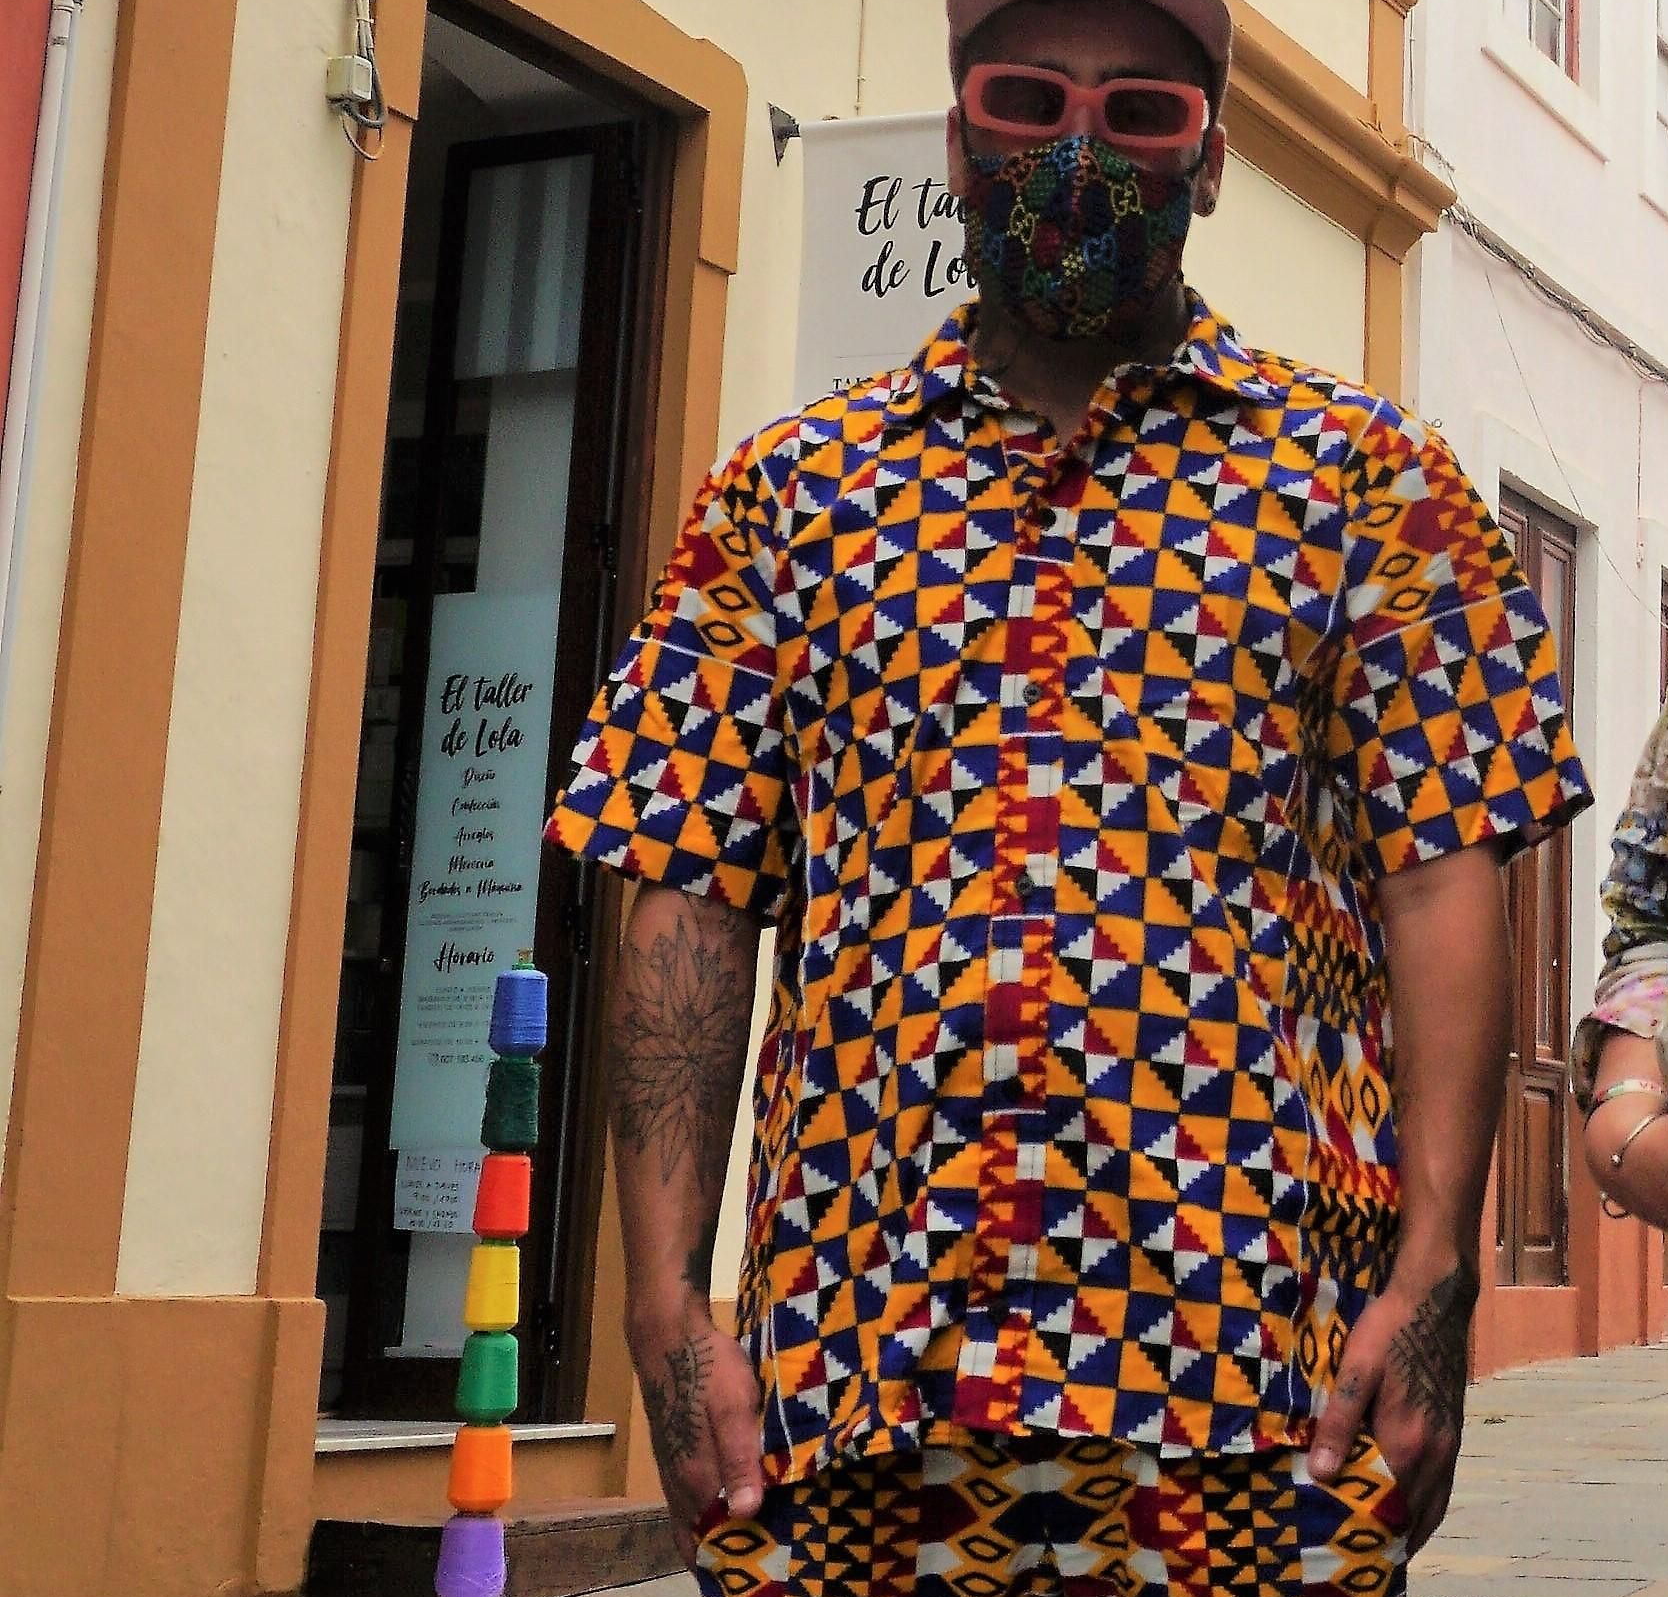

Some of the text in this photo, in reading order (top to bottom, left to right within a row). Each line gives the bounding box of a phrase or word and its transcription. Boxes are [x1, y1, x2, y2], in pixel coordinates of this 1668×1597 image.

[855, 176, 902, 235] El
[861, 240, 909, 298] de
[440, 672, 533, 714] El taller
[441, 716, 525, 757] de Lola
[433, 942, 495, 974] Horario
